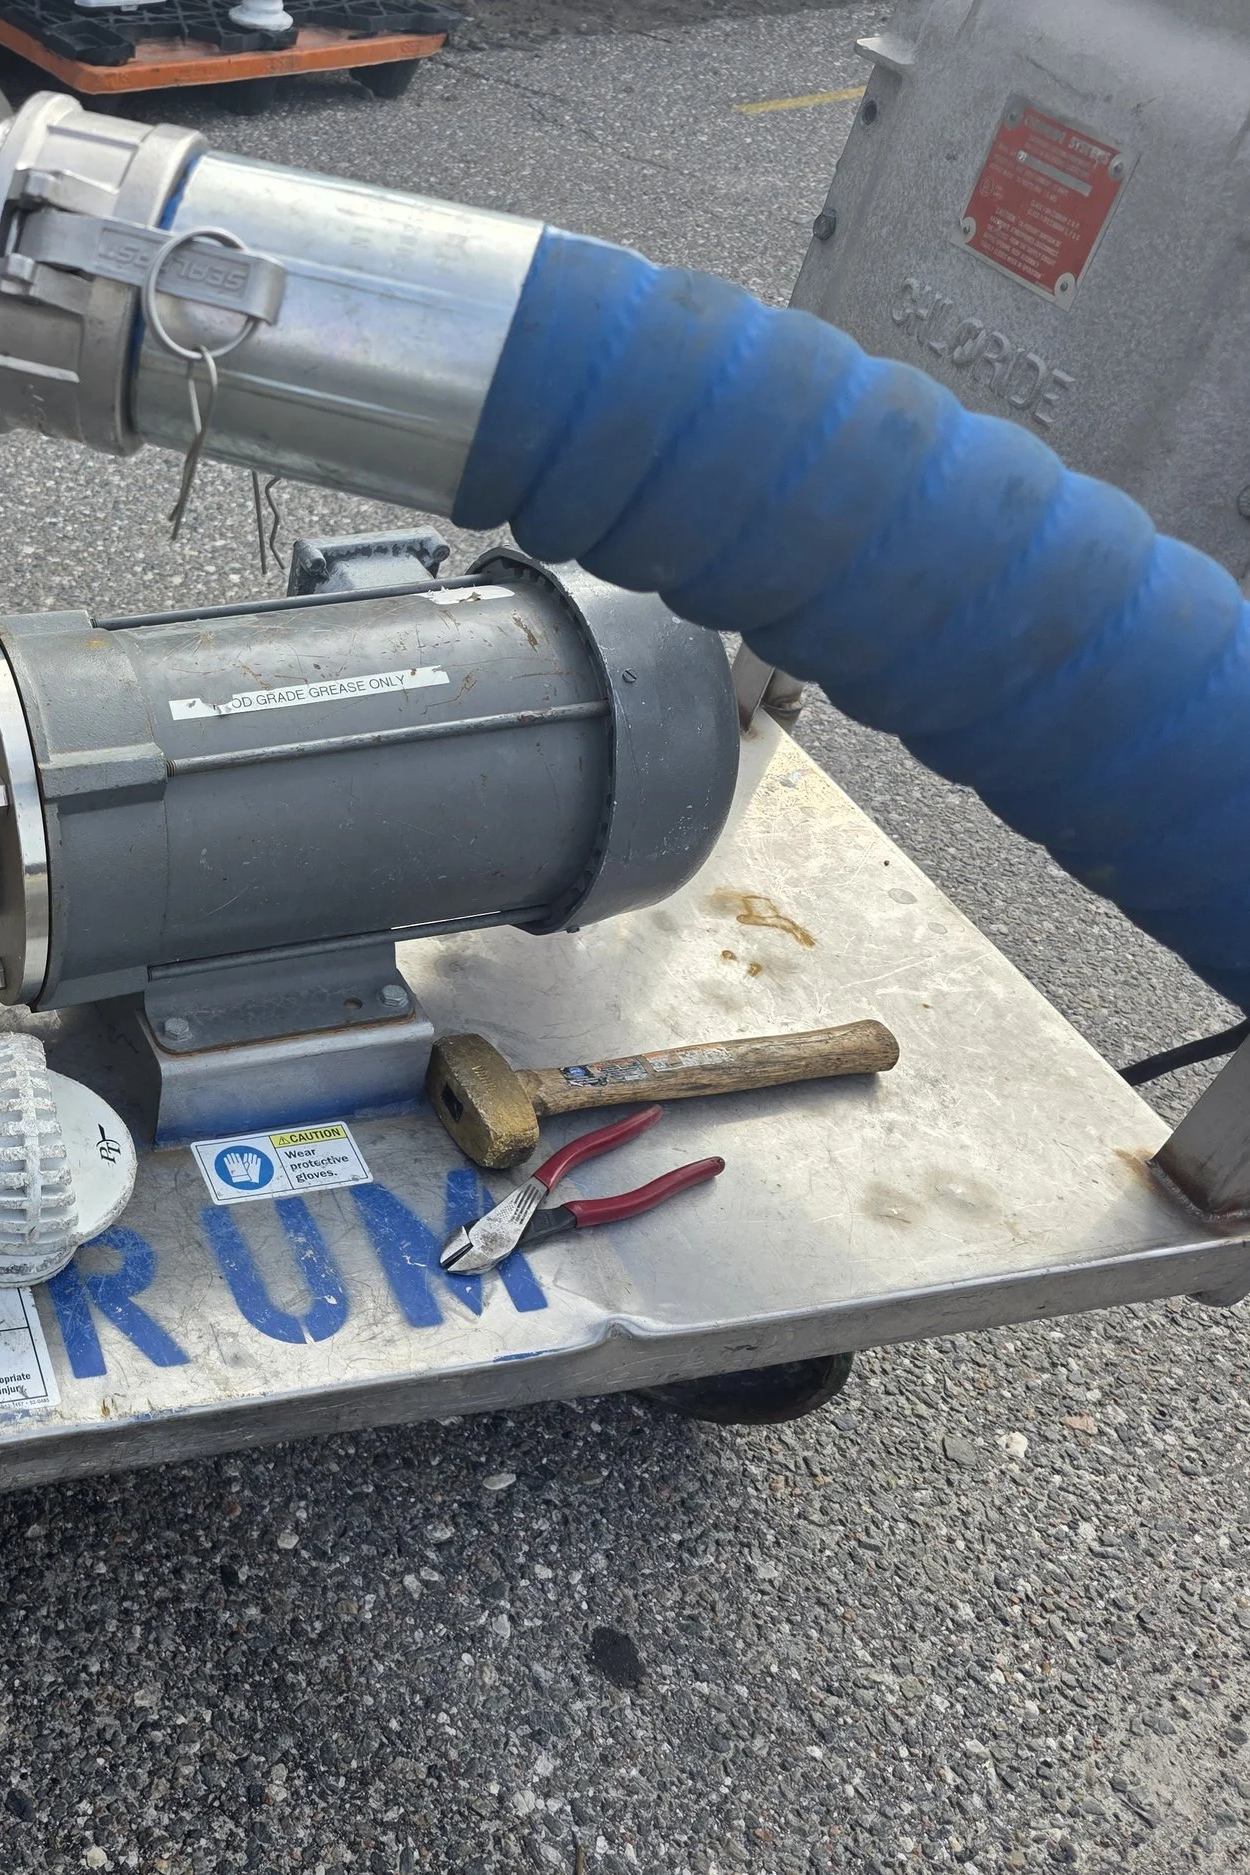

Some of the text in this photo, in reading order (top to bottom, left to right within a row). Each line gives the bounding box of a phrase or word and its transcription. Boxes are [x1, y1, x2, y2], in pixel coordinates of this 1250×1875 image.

[98, 245, 247, 291] SEALAST
[256, 689, 304, 706] GRADE
[308, 681, 365, 698] GREASE
[368, 674, 405, 690] ONLY
[289, 1127, 341, 1144] CAUTION
[284, 1148, 316, 1160] Wear
[290, 1154, 349, 1173] protective
[295, 1169, 338, 1184] gloves.
